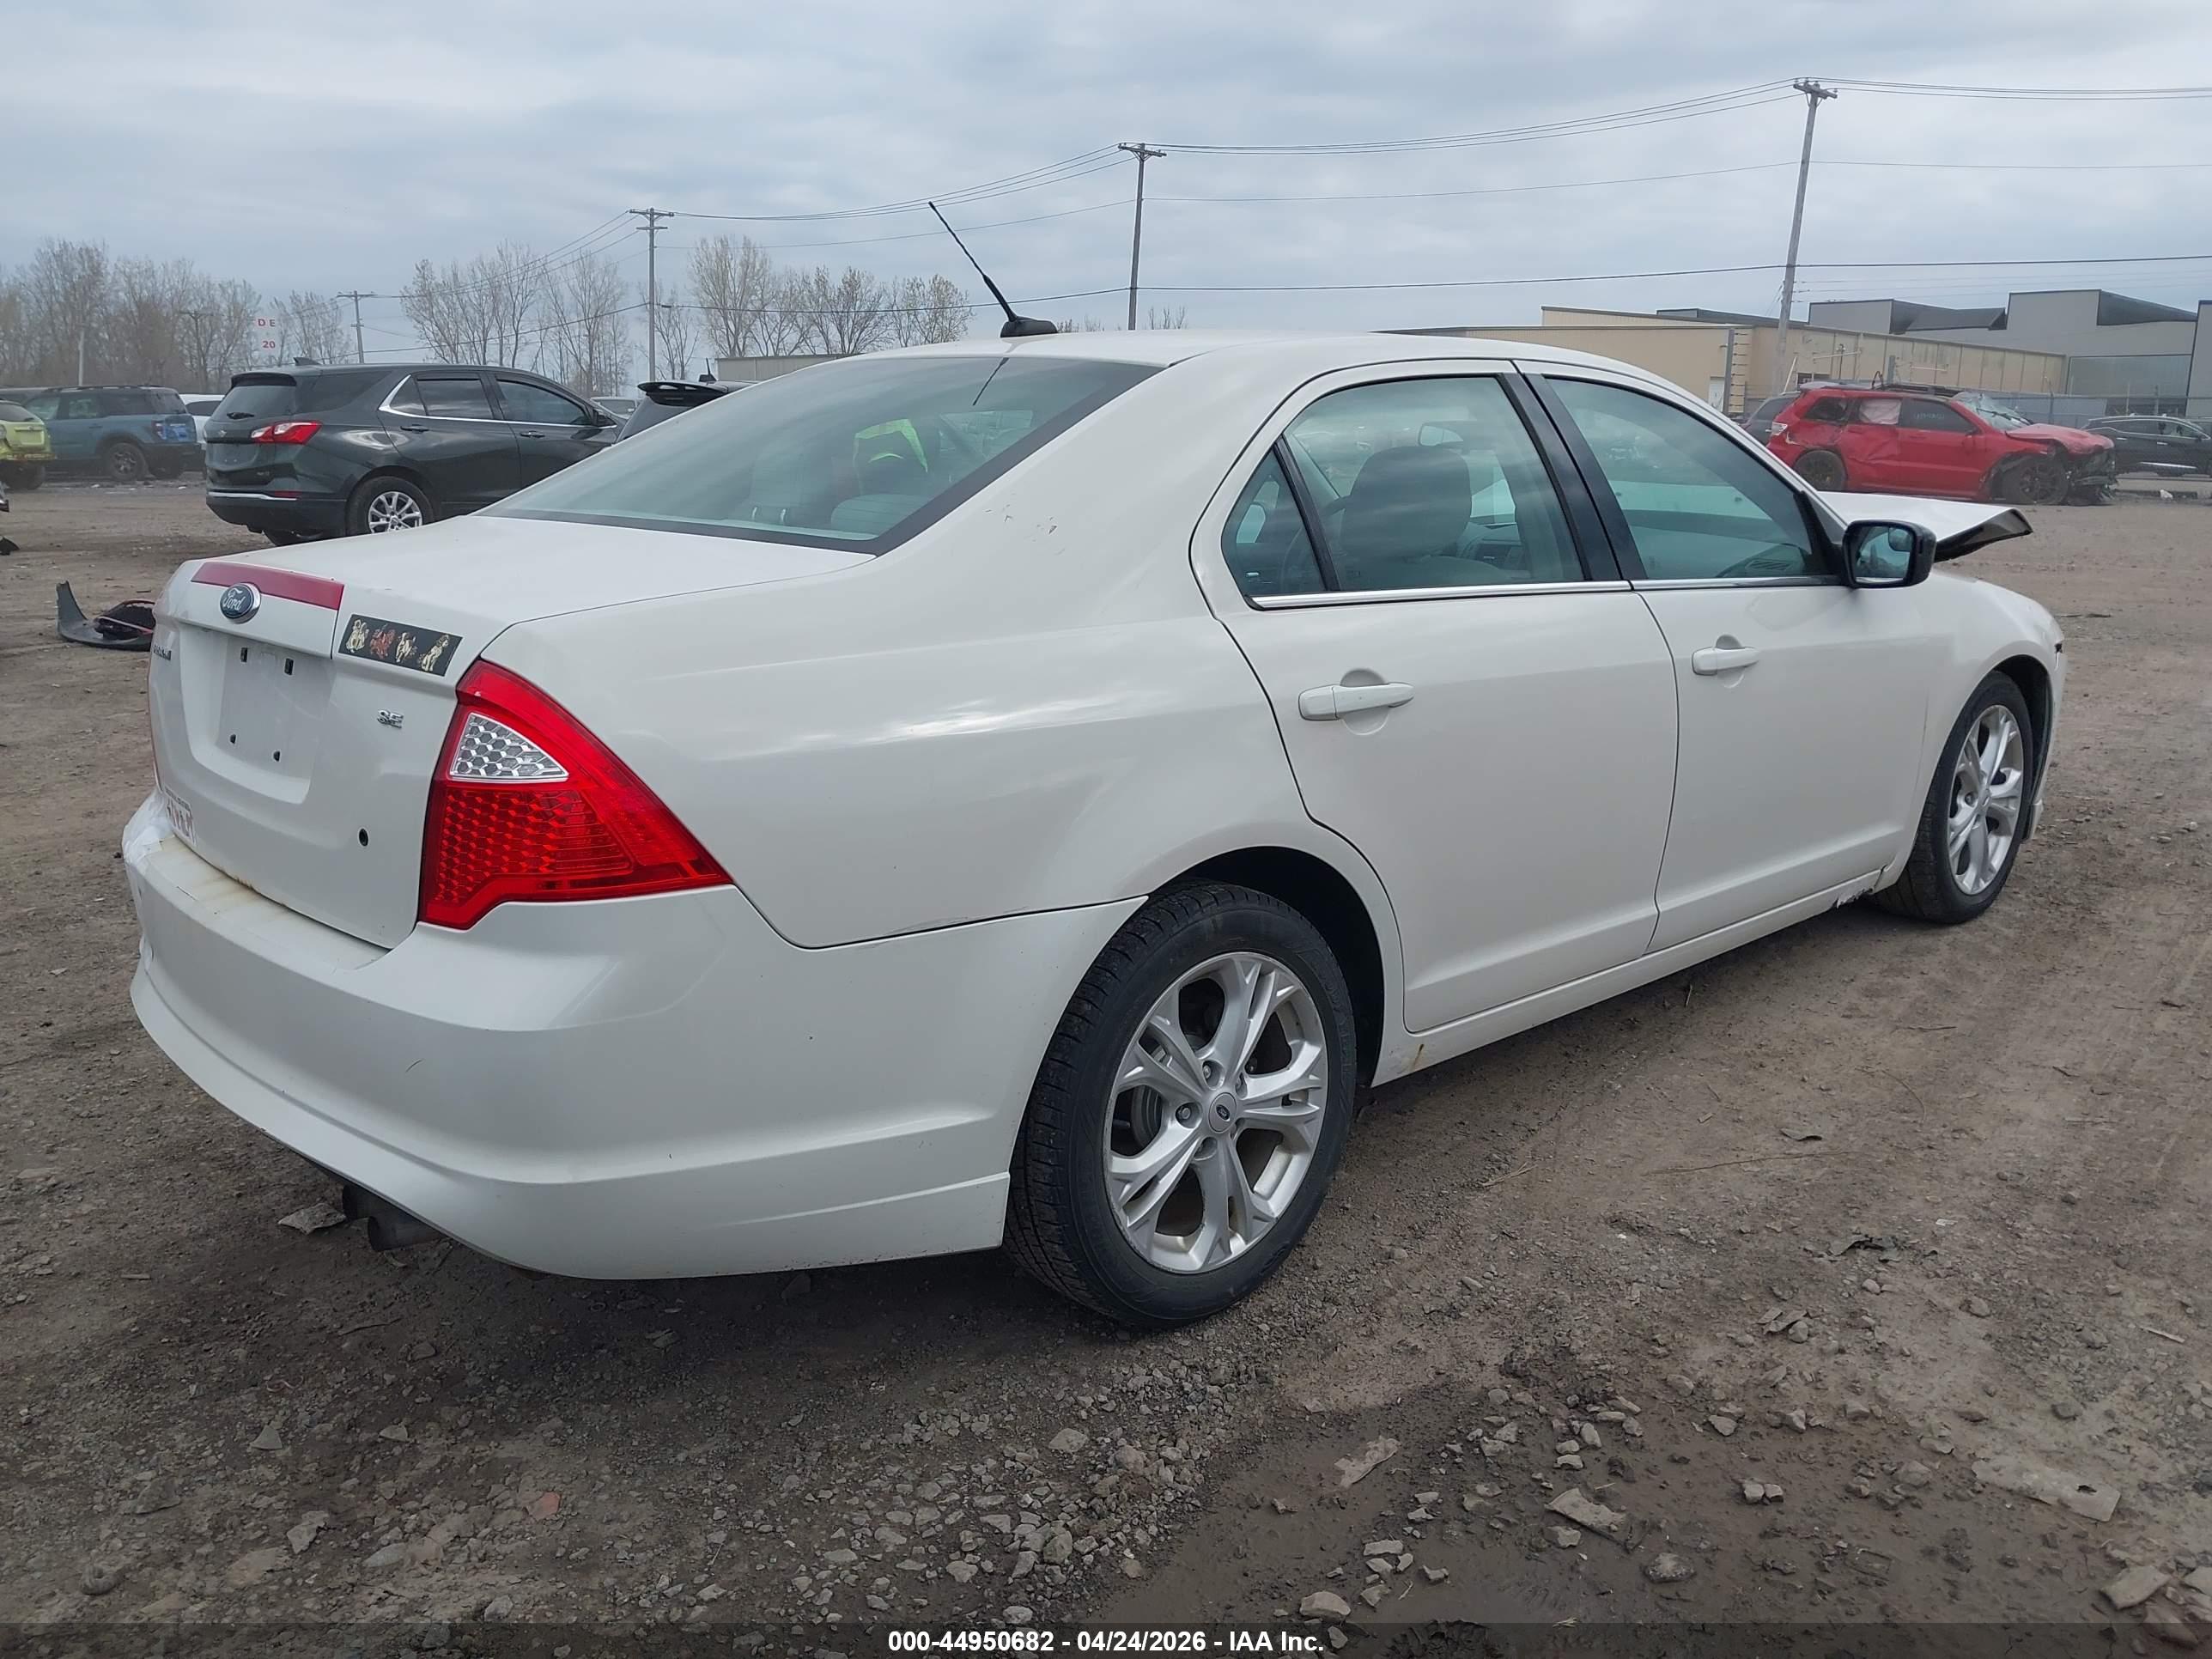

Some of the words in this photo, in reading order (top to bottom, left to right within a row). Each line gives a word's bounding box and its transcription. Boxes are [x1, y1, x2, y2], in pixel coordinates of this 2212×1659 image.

[262, 340, 276, 349] 20
[223, 587, 246, 611] Ford
[377, 709, 404, 729] SE
